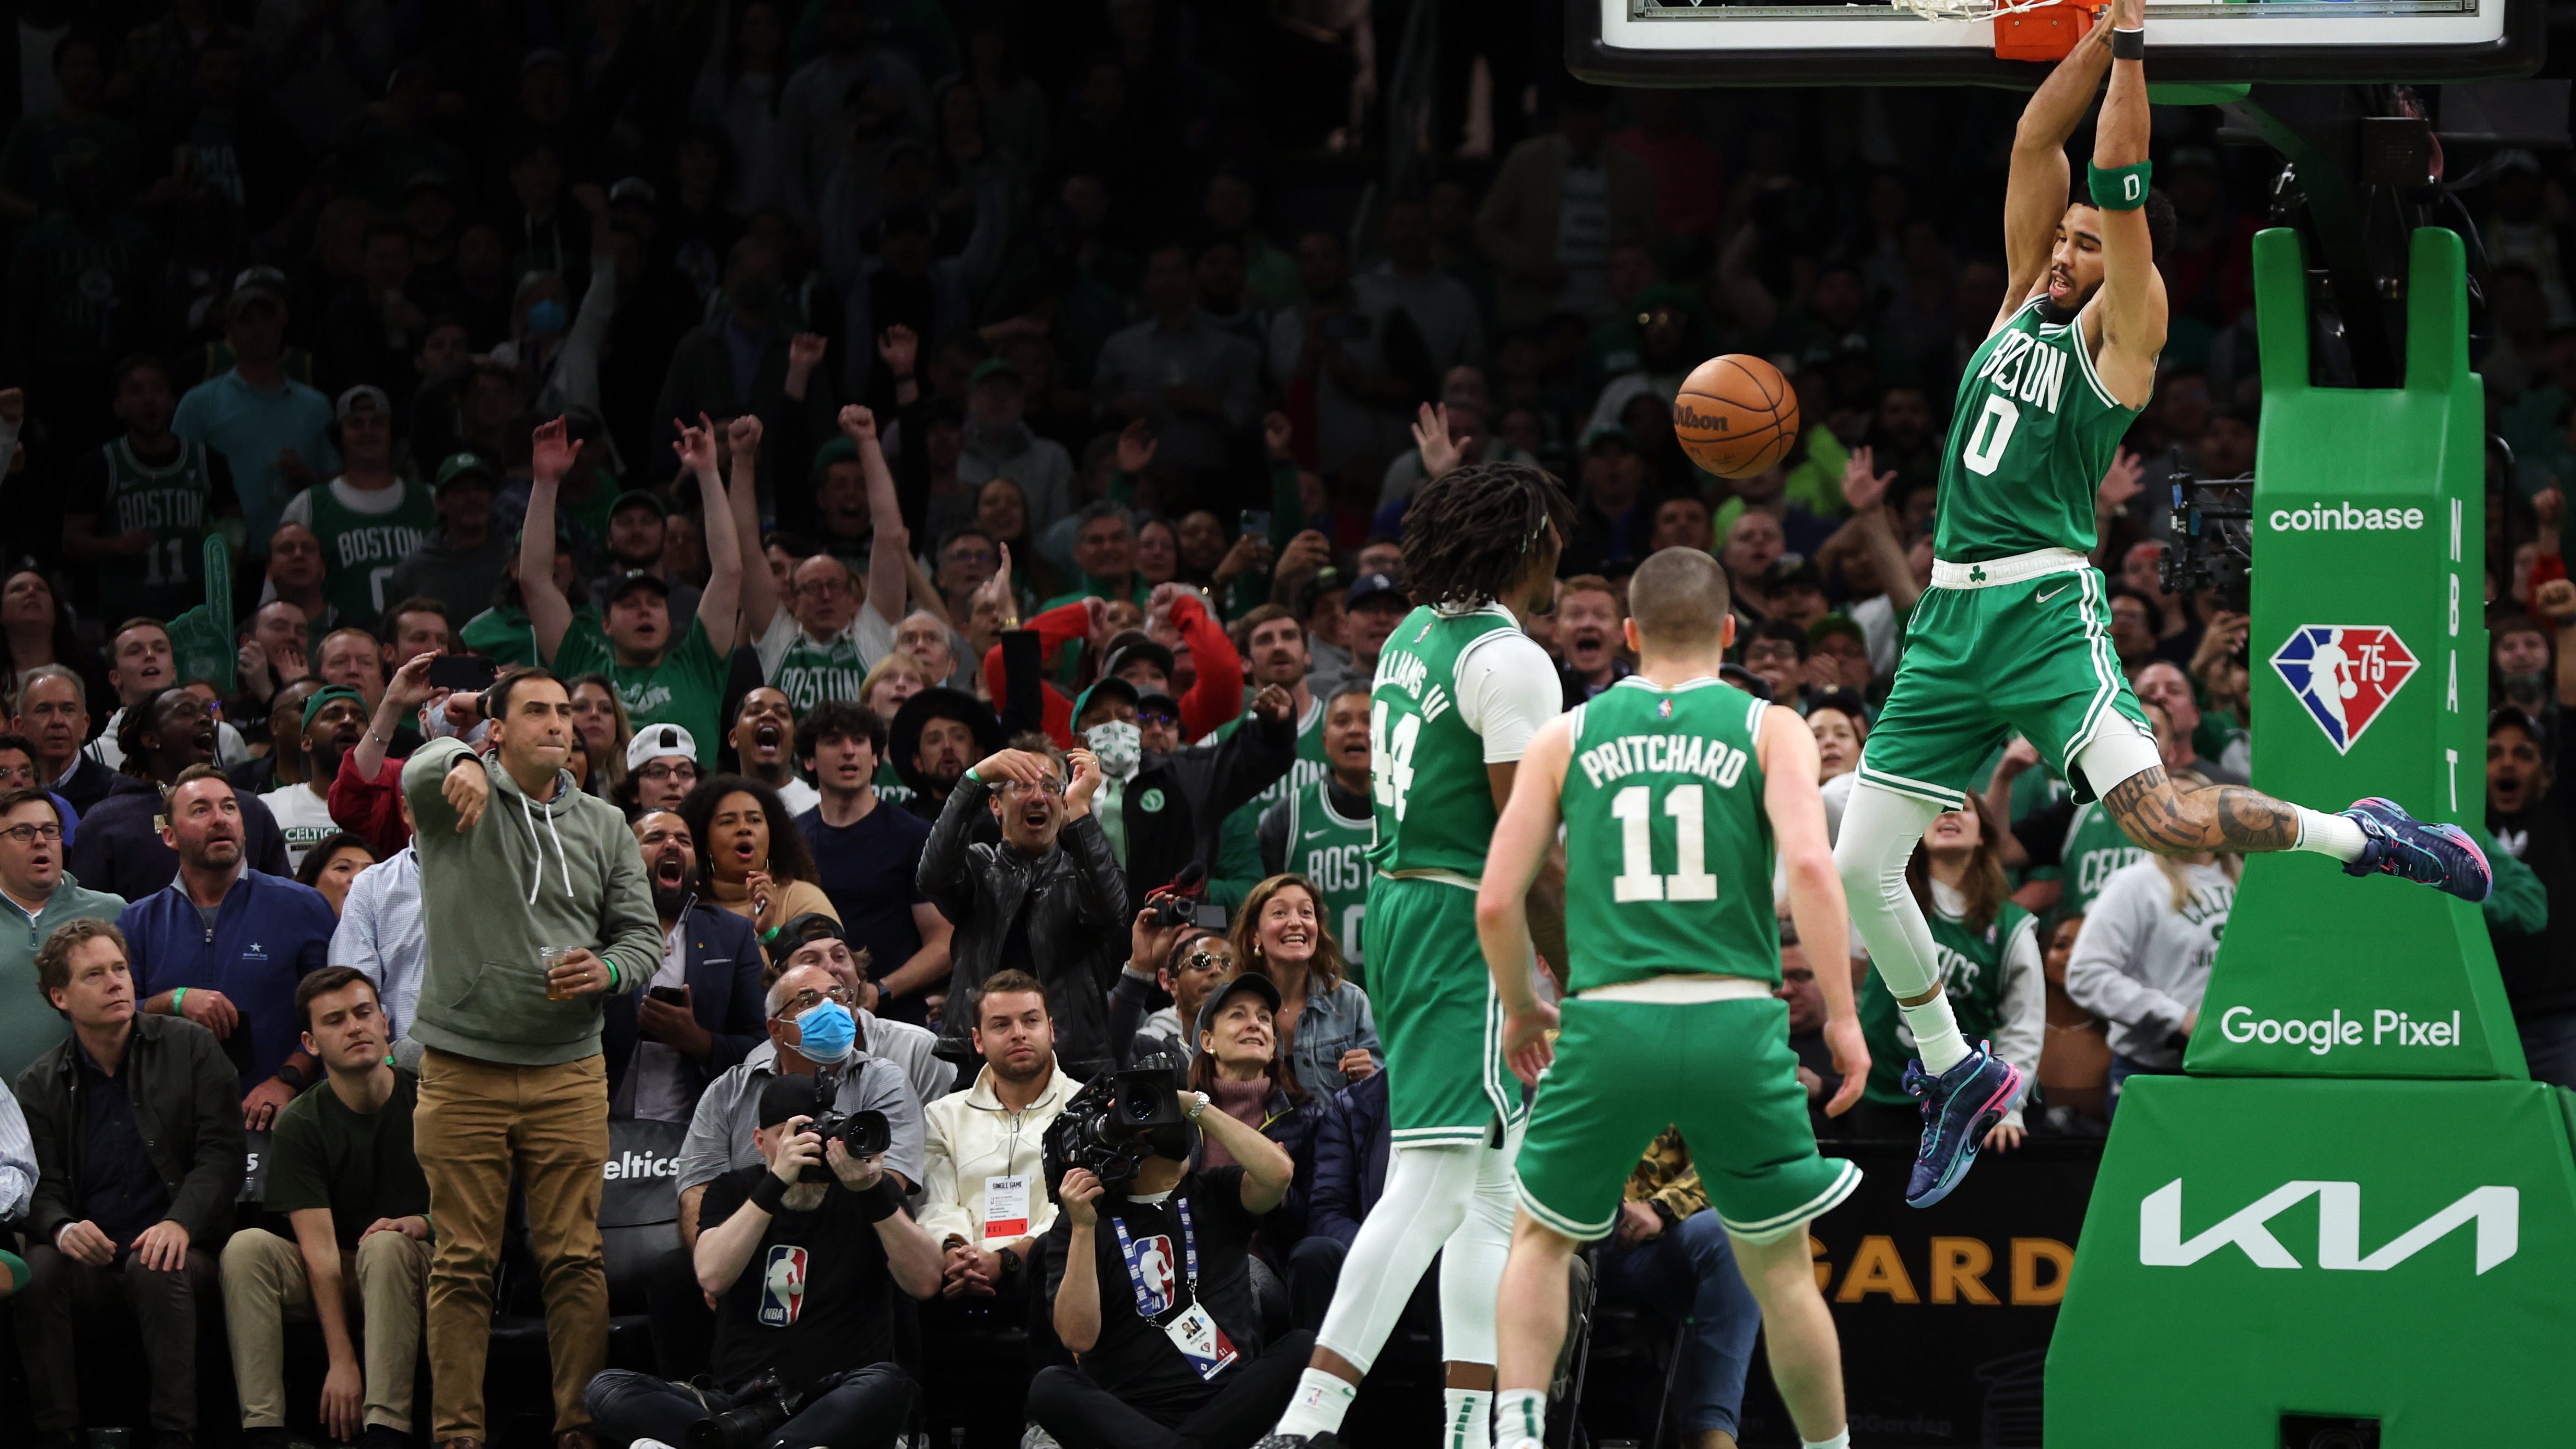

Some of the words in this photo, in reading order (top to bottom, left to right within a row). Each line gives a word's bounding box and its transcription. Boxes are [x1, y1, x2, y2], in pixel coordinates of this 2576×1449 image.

[1963, 393, 2020, 477] 0
[117, 488, 204, 535] BOSTON
[2269, 501, 2424, 531] coinbase
[143, 537, 189, 585] 11
[337, 528, 423, 569] BOSTON
[2358, 644, 2386, 682] 75
[780, 666, 861, 710] BOSTON
[1371, 698, 1421, 822] 44
[1579, 734, 1748, 789] PRITCHARD
[1611, 784, 1717, 903] 11
[2221, 1006, 2363, 1055] Google
[2374, 1009, 2460, 1046] Pixel
[2139, 1177, 2520, 1276] KIA
[764, 1307, 784, 1321] NBA
